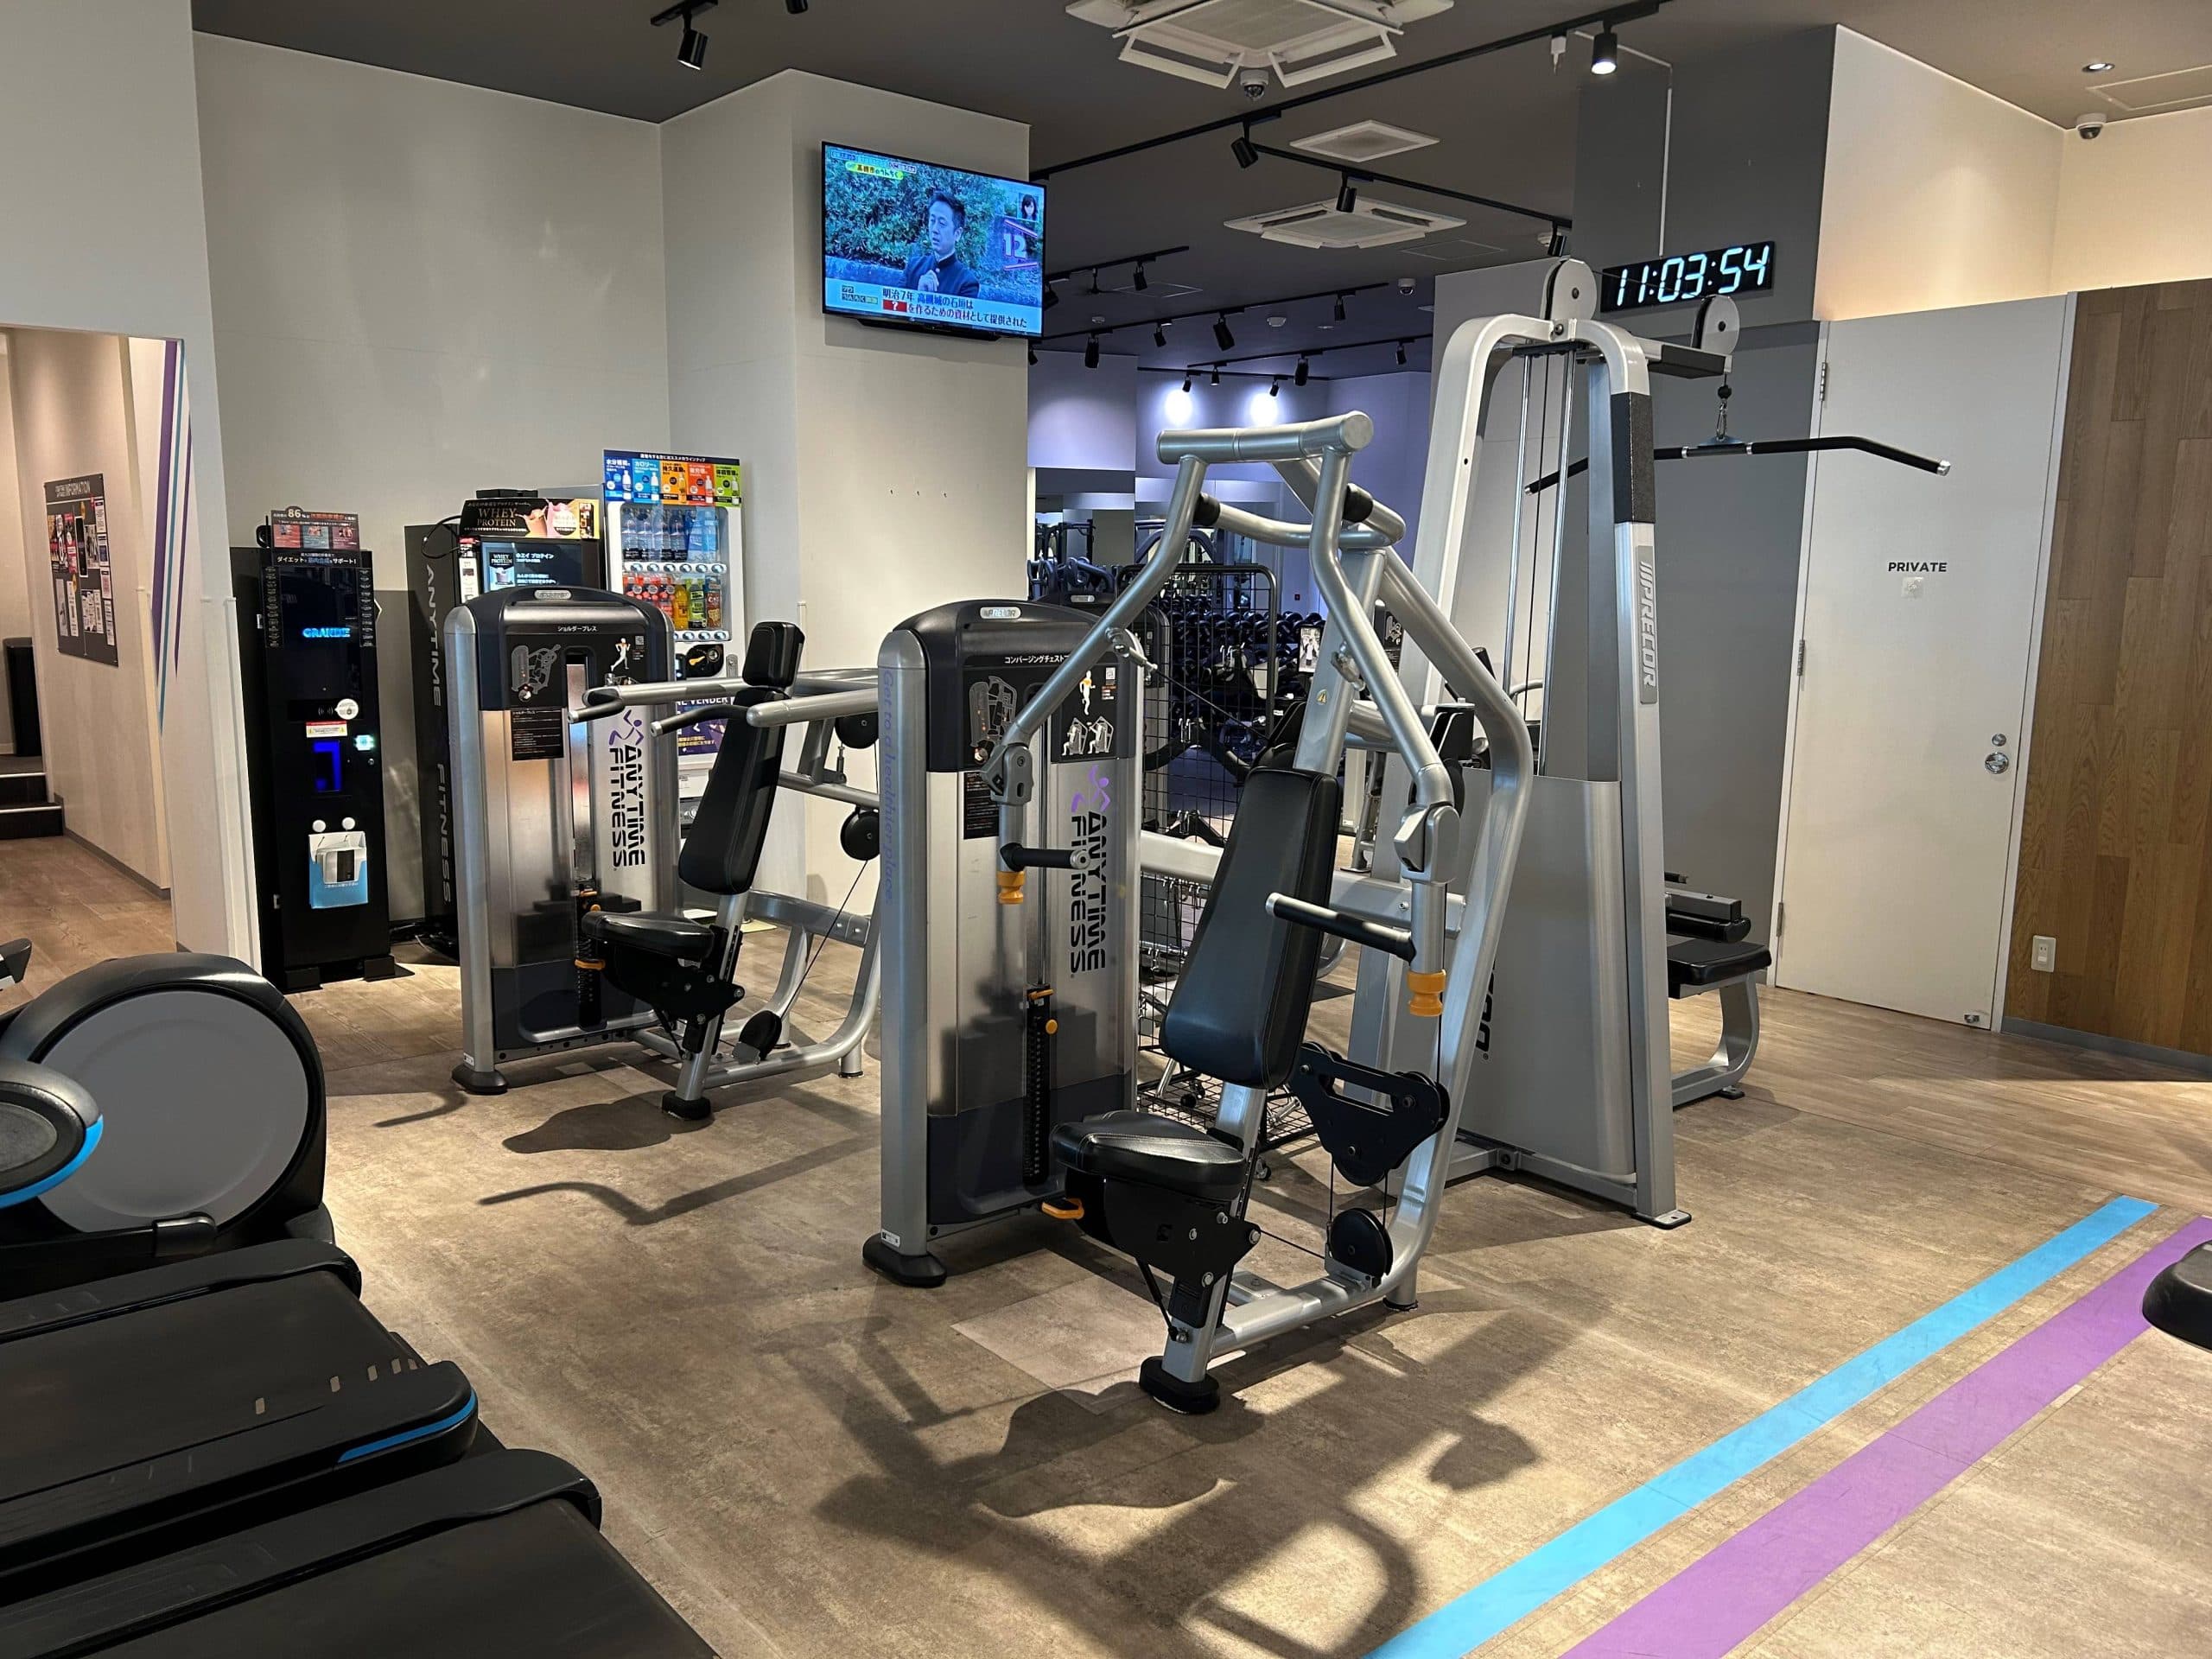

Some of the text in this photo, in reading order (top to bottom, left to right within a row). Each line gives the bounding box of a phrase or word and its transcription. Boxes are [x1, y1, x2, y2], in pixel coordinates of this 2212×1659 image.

[1617, 245, 1770, 306] 11:03:54
[477, 518, 516, 527] PROTEIN
[478, 507, 517, 518] WHEY
[1888, 562, 1948, 572] PRIVATE
[1004, 655, 1071, 664] コンバージングチェスト
[1640, 577, 1656, 688] PRECOR
[884, 671, 895, 706] Get
[884, 712, 894, 731] to
[427, 564, 452, 903] ANYTIME FITNESS
[609, 747, 627, 868] FITNESS
[624, 744, 645, 866] ANYTIME
[884, 753, 896, 844] healthier
[1071, 815, 1087, 974] FINESS
[1087, 810, 1107, 971] ANYTIME
